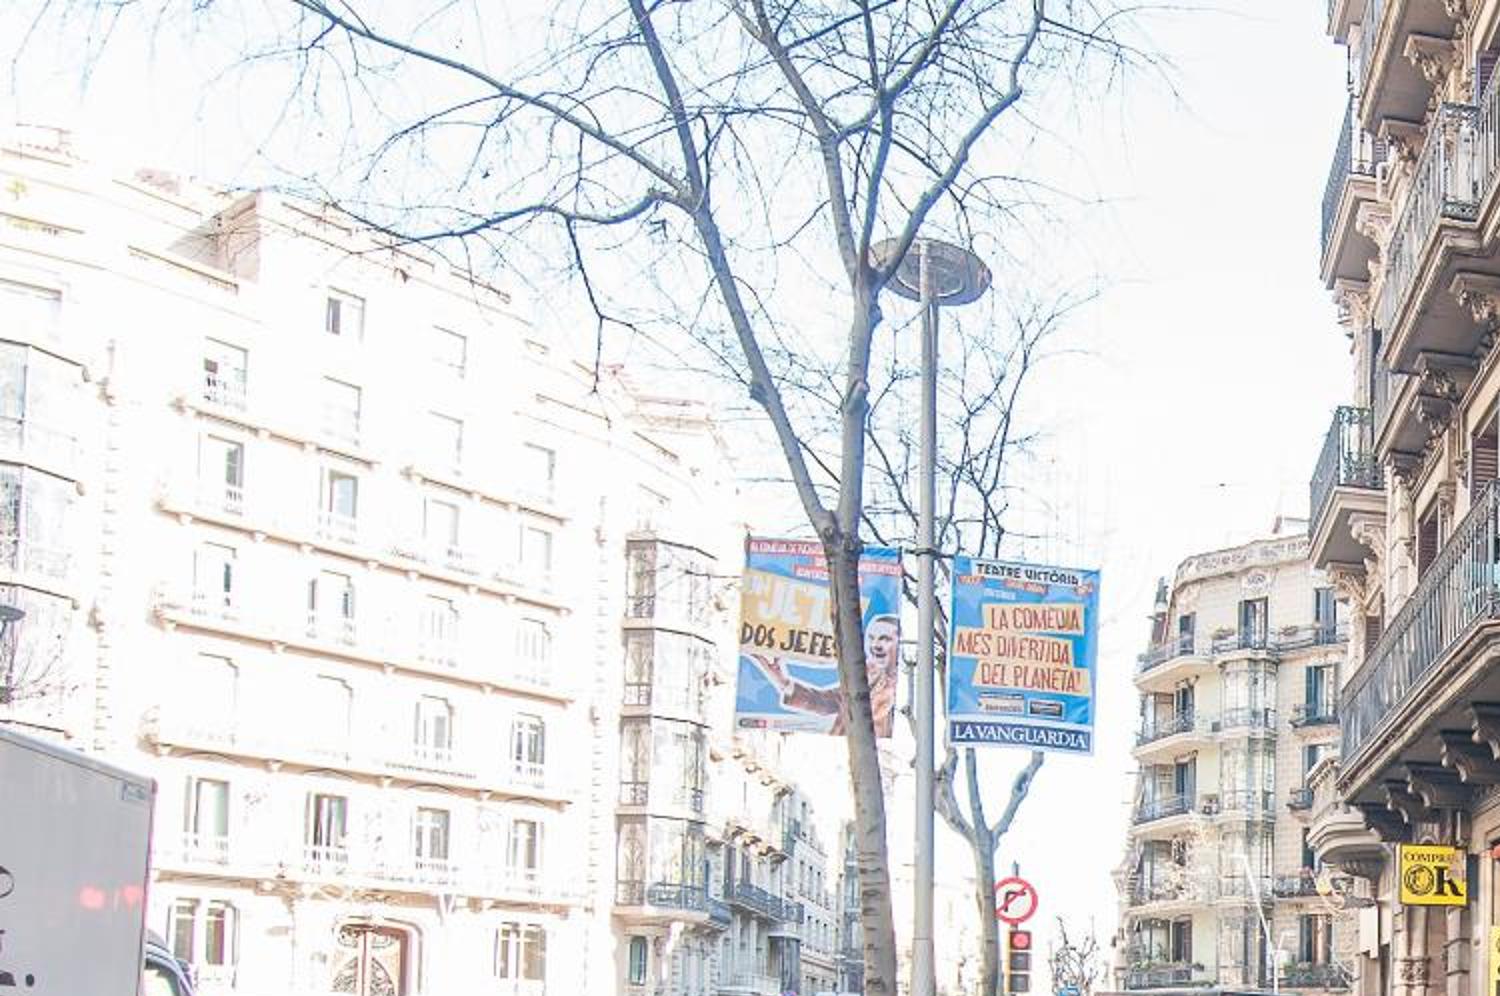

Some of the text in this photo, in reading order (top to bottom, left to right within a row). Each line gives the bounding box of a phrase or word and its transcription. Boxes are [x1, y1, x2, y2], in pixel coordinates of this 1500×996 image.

[976, 563, 1021, 578] TEATRE
[991, 607, 1008, 630] LA
[740, 622, 775, 648] DOS
[997, 635, 1070, 665] DIVERTIDA
[981, 662, 1008, 686] DEL
